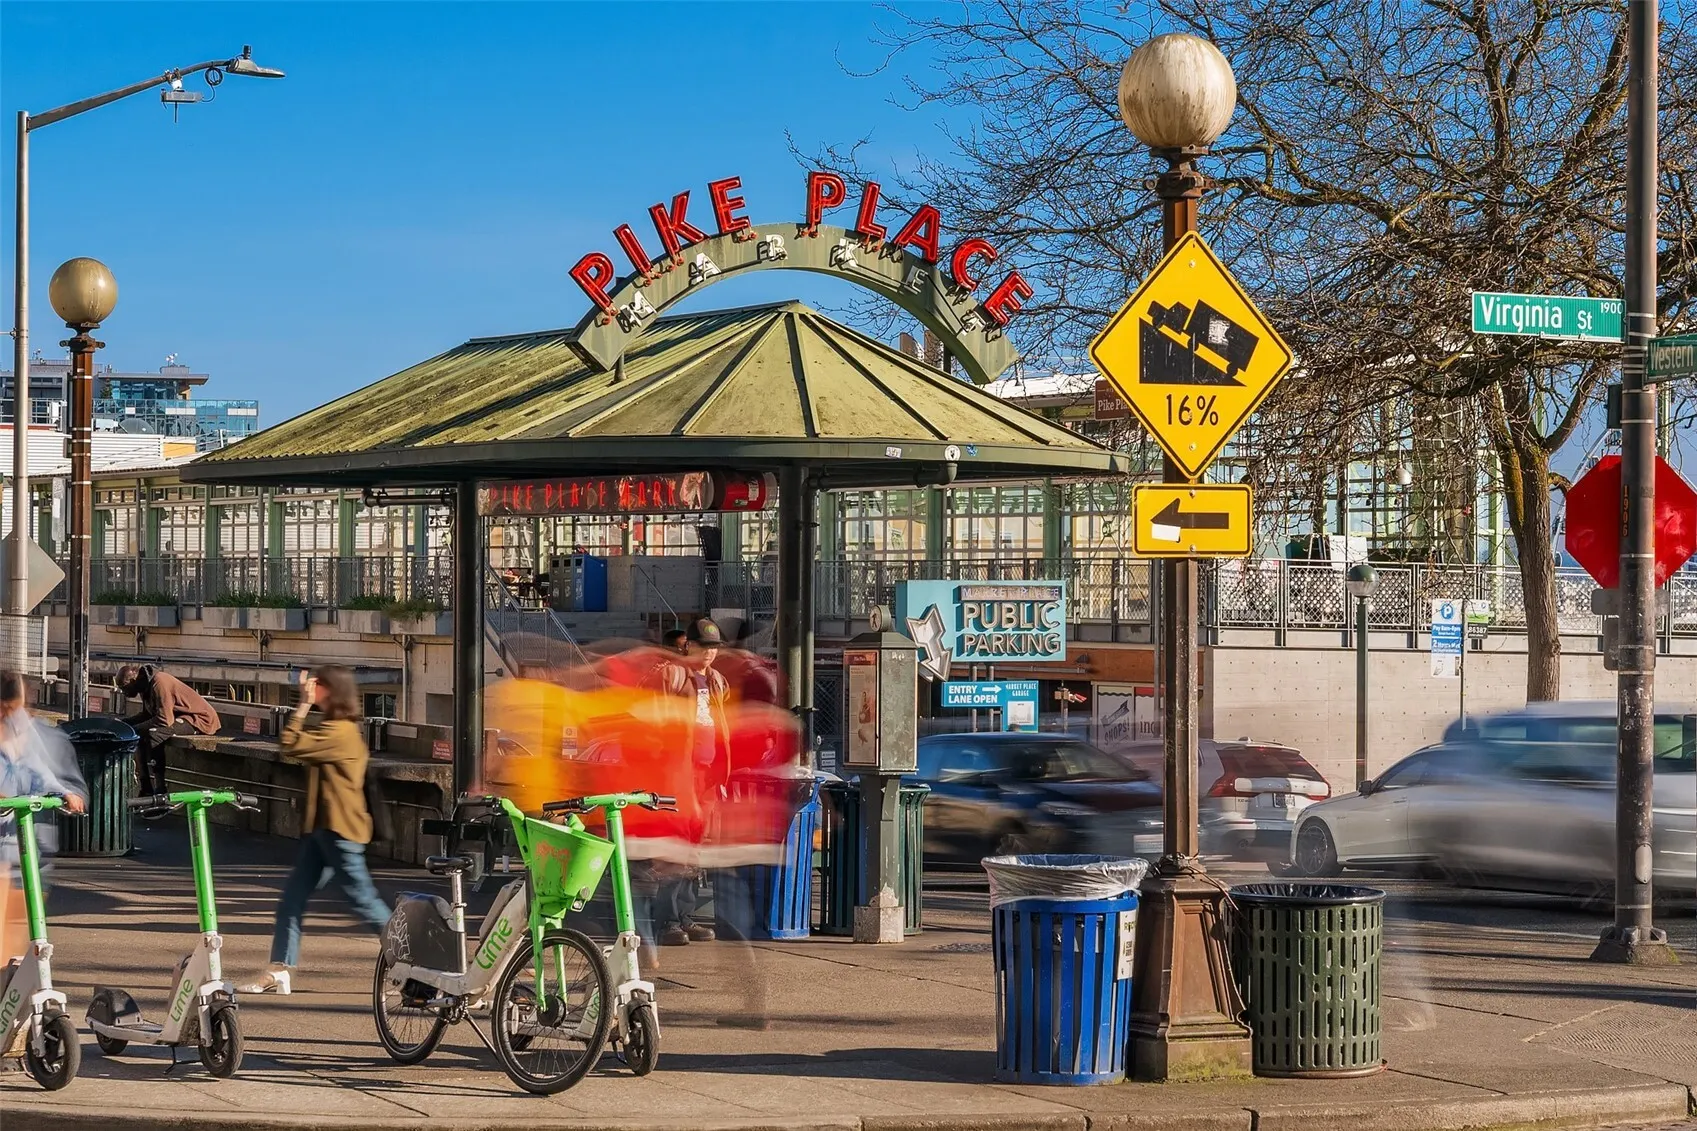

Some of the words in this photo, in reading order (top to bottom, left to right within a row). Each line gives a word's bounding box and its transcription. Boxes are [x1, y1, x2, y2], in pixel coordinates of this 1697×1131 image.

[569, 175, 751, 311] PIKE
[807, 171, 1034, 326] PLACE
[1480, 296, 1562, 332] Virginia
[1576, 309, 1592, 331] St
[1600, 302, 1623, 315] 1900
[1650, 342, 1694, 370] Western
[1097, 399, 1115, 412] Pike
[1165, 393, 1219, 426] 16%
[488, 485, 534, 511] PIKE
[963, 602, 1061, 629] PUBLIC
[964, 633, 1061, 653] PARKING
[948, 685, 978, 694] ENTRY
[948, 695, 973, 704] LANE
[973, 695, 998, 704] OPEN
